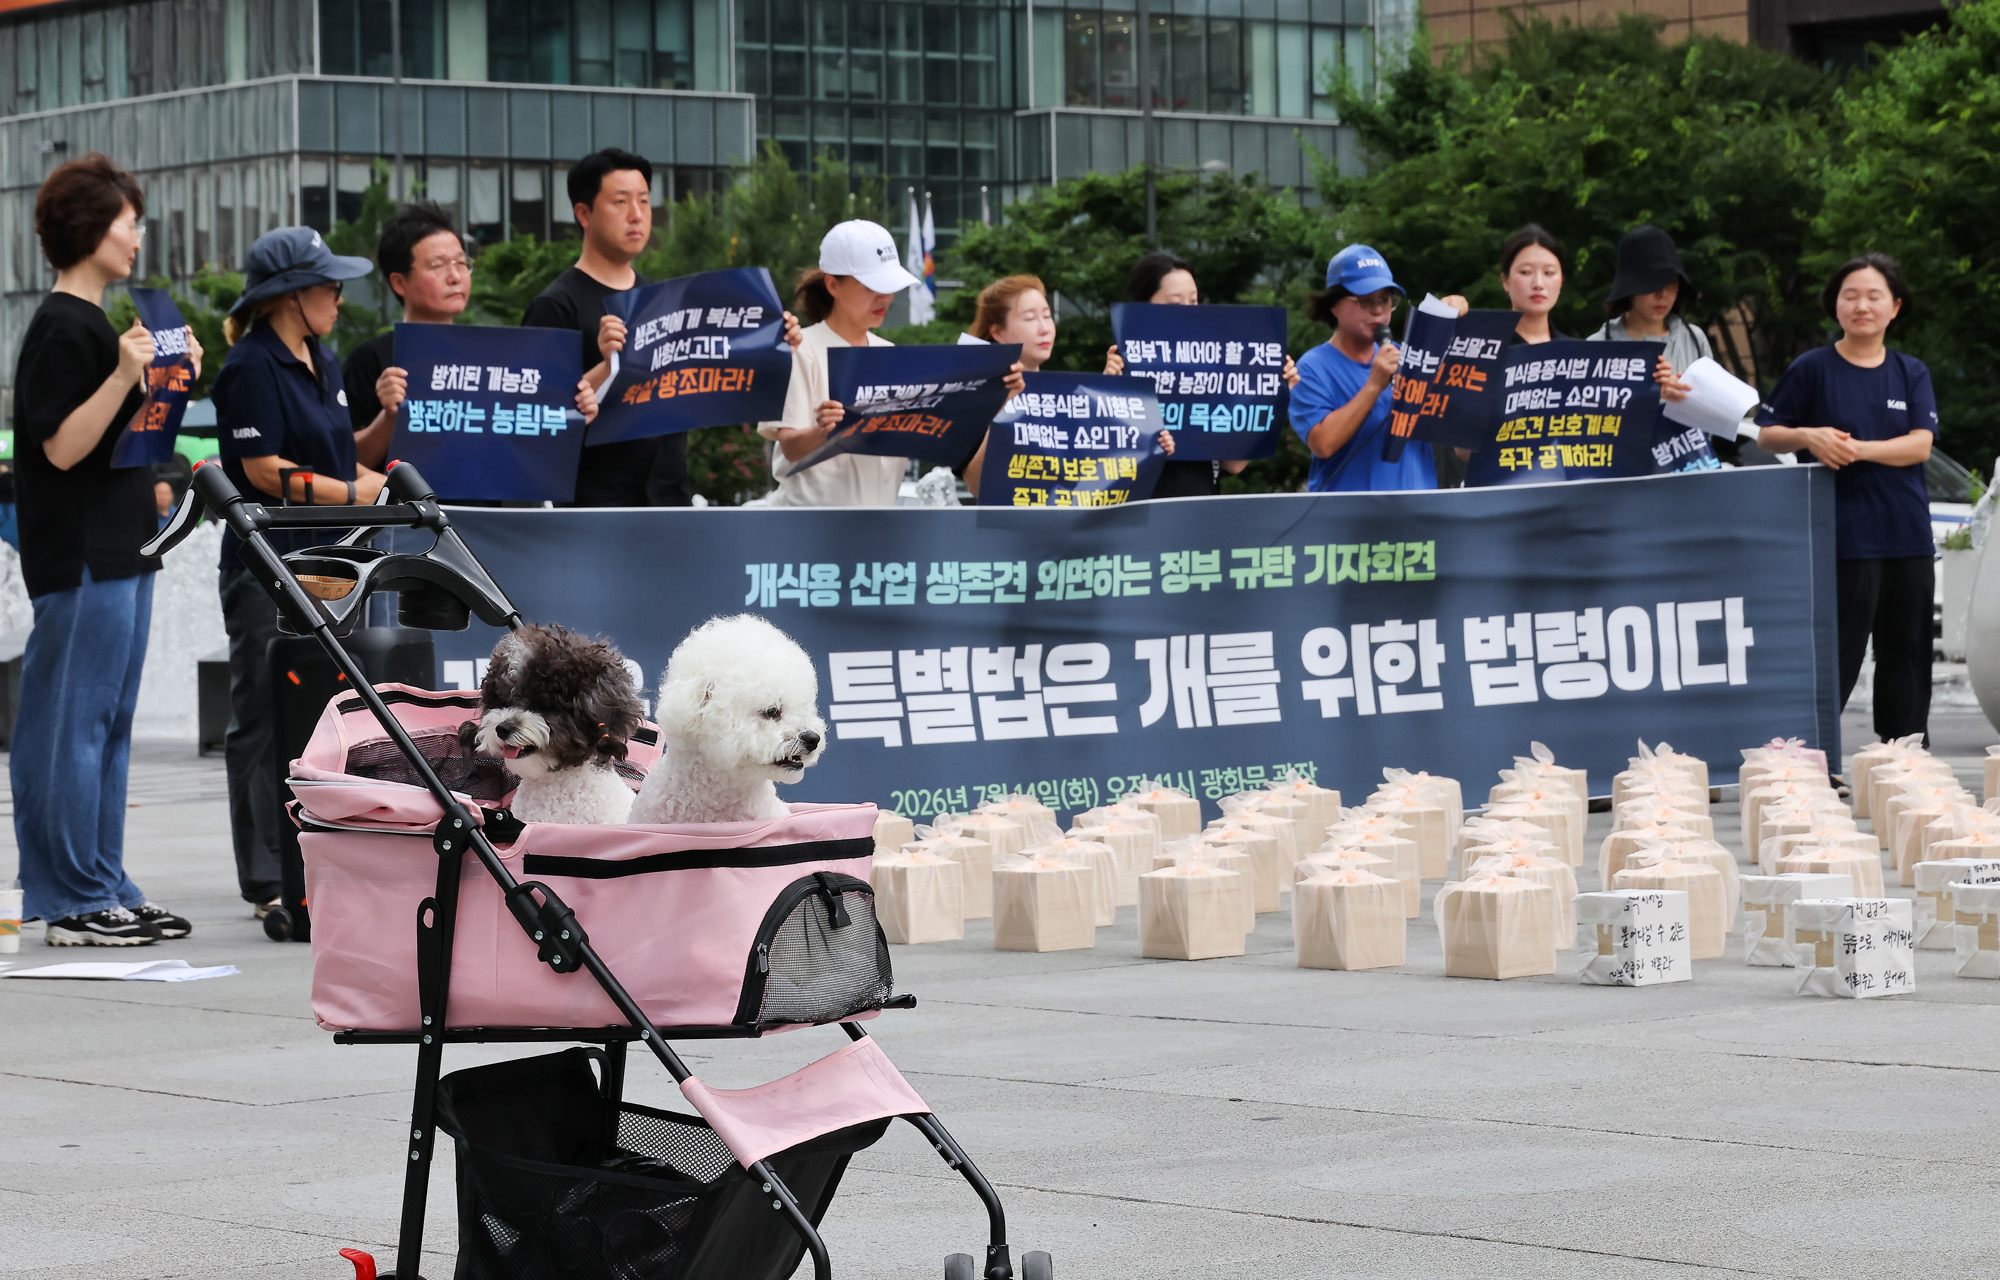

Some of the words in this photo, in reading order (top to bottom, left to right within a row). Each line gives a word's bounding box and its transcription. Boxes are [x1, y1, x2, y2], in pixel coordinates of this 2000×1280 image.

[634, 308, 703, 351] 생존견에게
[706, 306, 763, 328] 복날은
[651, 336, 731, 371] 사형선고다
[1125, 340, 1171, 364] 정부가
[1176, 341, 1222, 364] 세어야
[1225, 341, 1244, 366] 할
[1248, 342, 1282, 367] 것은
[431, 365, 481, 391] 방치된
[487, 366, 541, 394] 개농장
[658, 368, 755, 399] 방조마라!
[1179, 372, 1224, 395] 농장이
[1227, 373, 1280, 396] 아니라
[1504, 358, 1589, 388] 개식용종식법
[1591, 358, 1646, 381] 시행은
[1096, 396, 1146, 419] 시행은
[1505, 388, 1562, 415] 대책없는
[1564, 386, 1632, 410] 쇼인가?
[408, 399, 485, 433] 방관하는
[492, 402, 567, 436] 농림부
[1189, 403, 1274, 433] 목숨이다
[1495, 416, 1545, 442] 생존견
[1547, 413, 1622, 437] 보호계획
[1014, 423, 1069, 449] 대책없는
[1074, 426, 1140, 449] 쇼인가?
[1651, 428, 1707, 466] 방치된
[1008, 454, 1060, 480] 생존견
[1063, 457, 1137, 481] 보호계획
[1498, 447, 1533, 471] 즉각
[1538, 444, 1614, 469] 공개하라!
[745, 563, 842, 608] 개식용
[850, 562, 917, 606] 산업
[926, 560, 1027, 605] 생존견
[1035, 554, 1152, 601] 외면하는
[1160, 549, 1222, 594] 정부
[1229, 546, 1296, 590] 규탄
[1304, 540, 1437, 585] 기자회견
[829, 642, 1119, 748] 특별법은
[1135, 631, 1281, 729] 개를
[1300, 618, 1446, 719] 위한
[1463, 596, 1755, 707] 법령이다
[890, 785, 968, 817] 2026년
